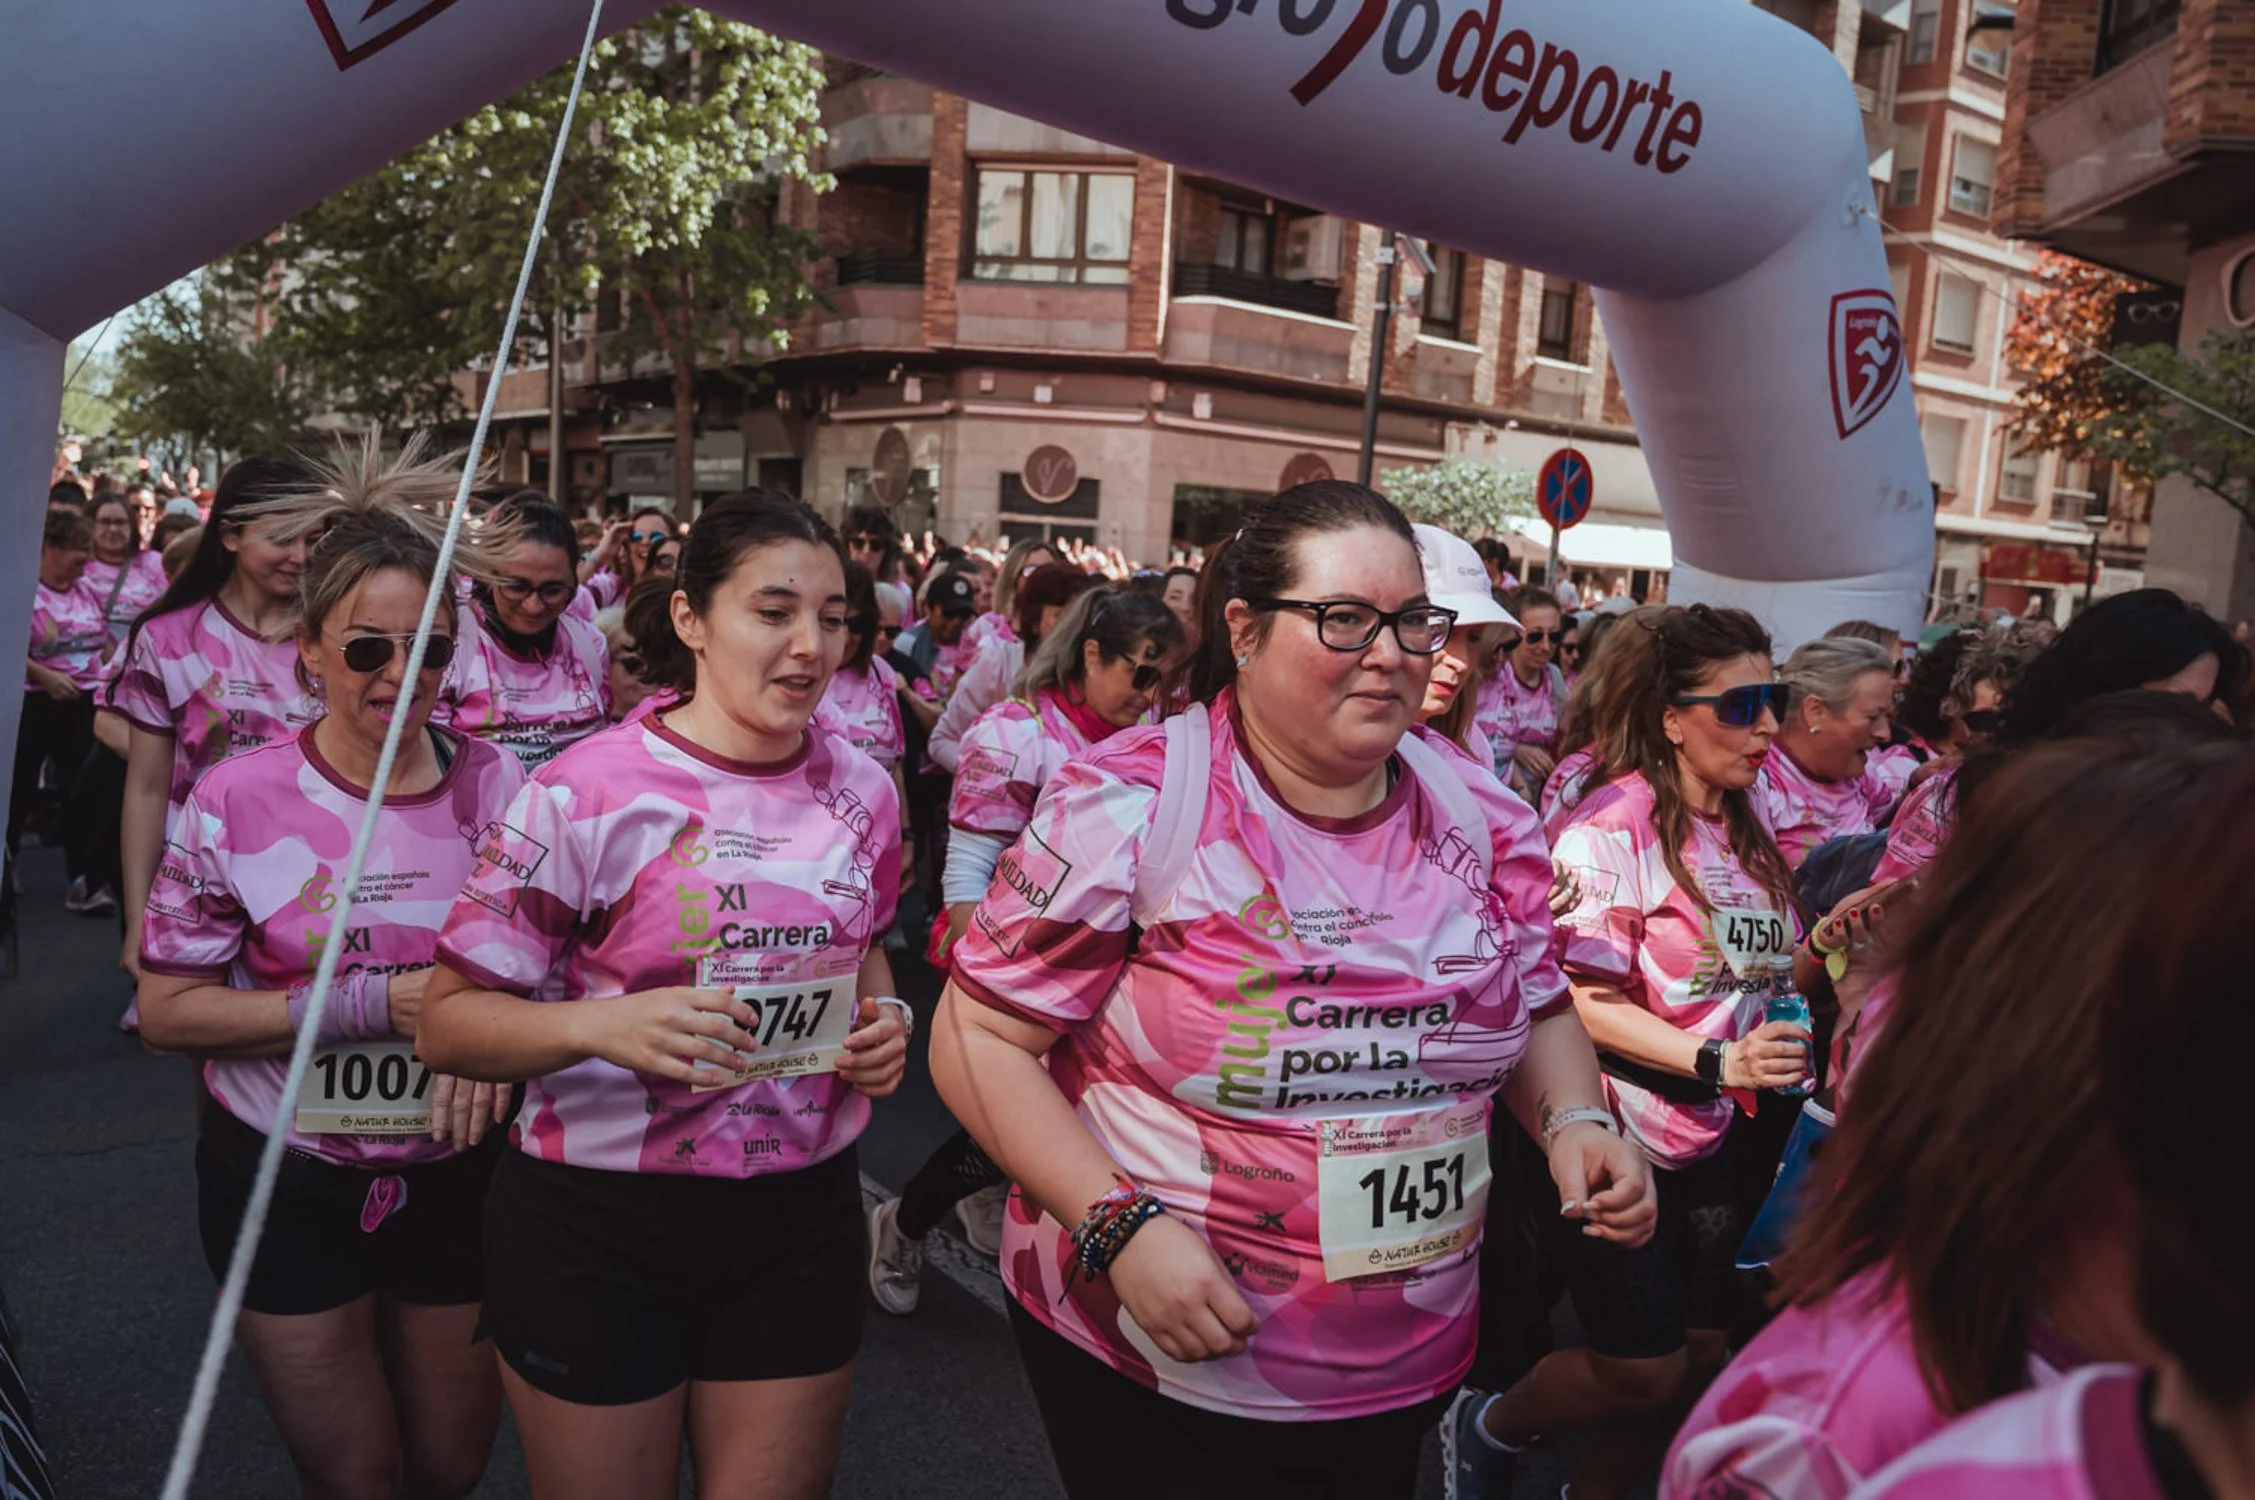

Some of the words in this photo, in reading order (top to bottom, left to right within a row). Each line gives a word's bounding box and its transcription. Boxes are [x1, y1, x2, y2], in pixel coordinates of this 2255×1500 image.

[714, 884, 747, 913] XI
[342, 927, 371, 954] XI
[719, 921, 829, 950] Carrera
[1727, 916, 1784, 954] 4750
[1286, 995, 1450, 1030] Carrera
[313, 1053, 432, 1101] 1007
[1280, 1048, 1360, 1083] por
[1369, 1041, 1409, 1072] la
[1333, 1128, 1346, 1141] XI
[1347, 1129, 1386, 1140] Carrera
[1224, 1160, 1296, 1183] Logroño
[1359, 1152, 1464, 1229] 1451
